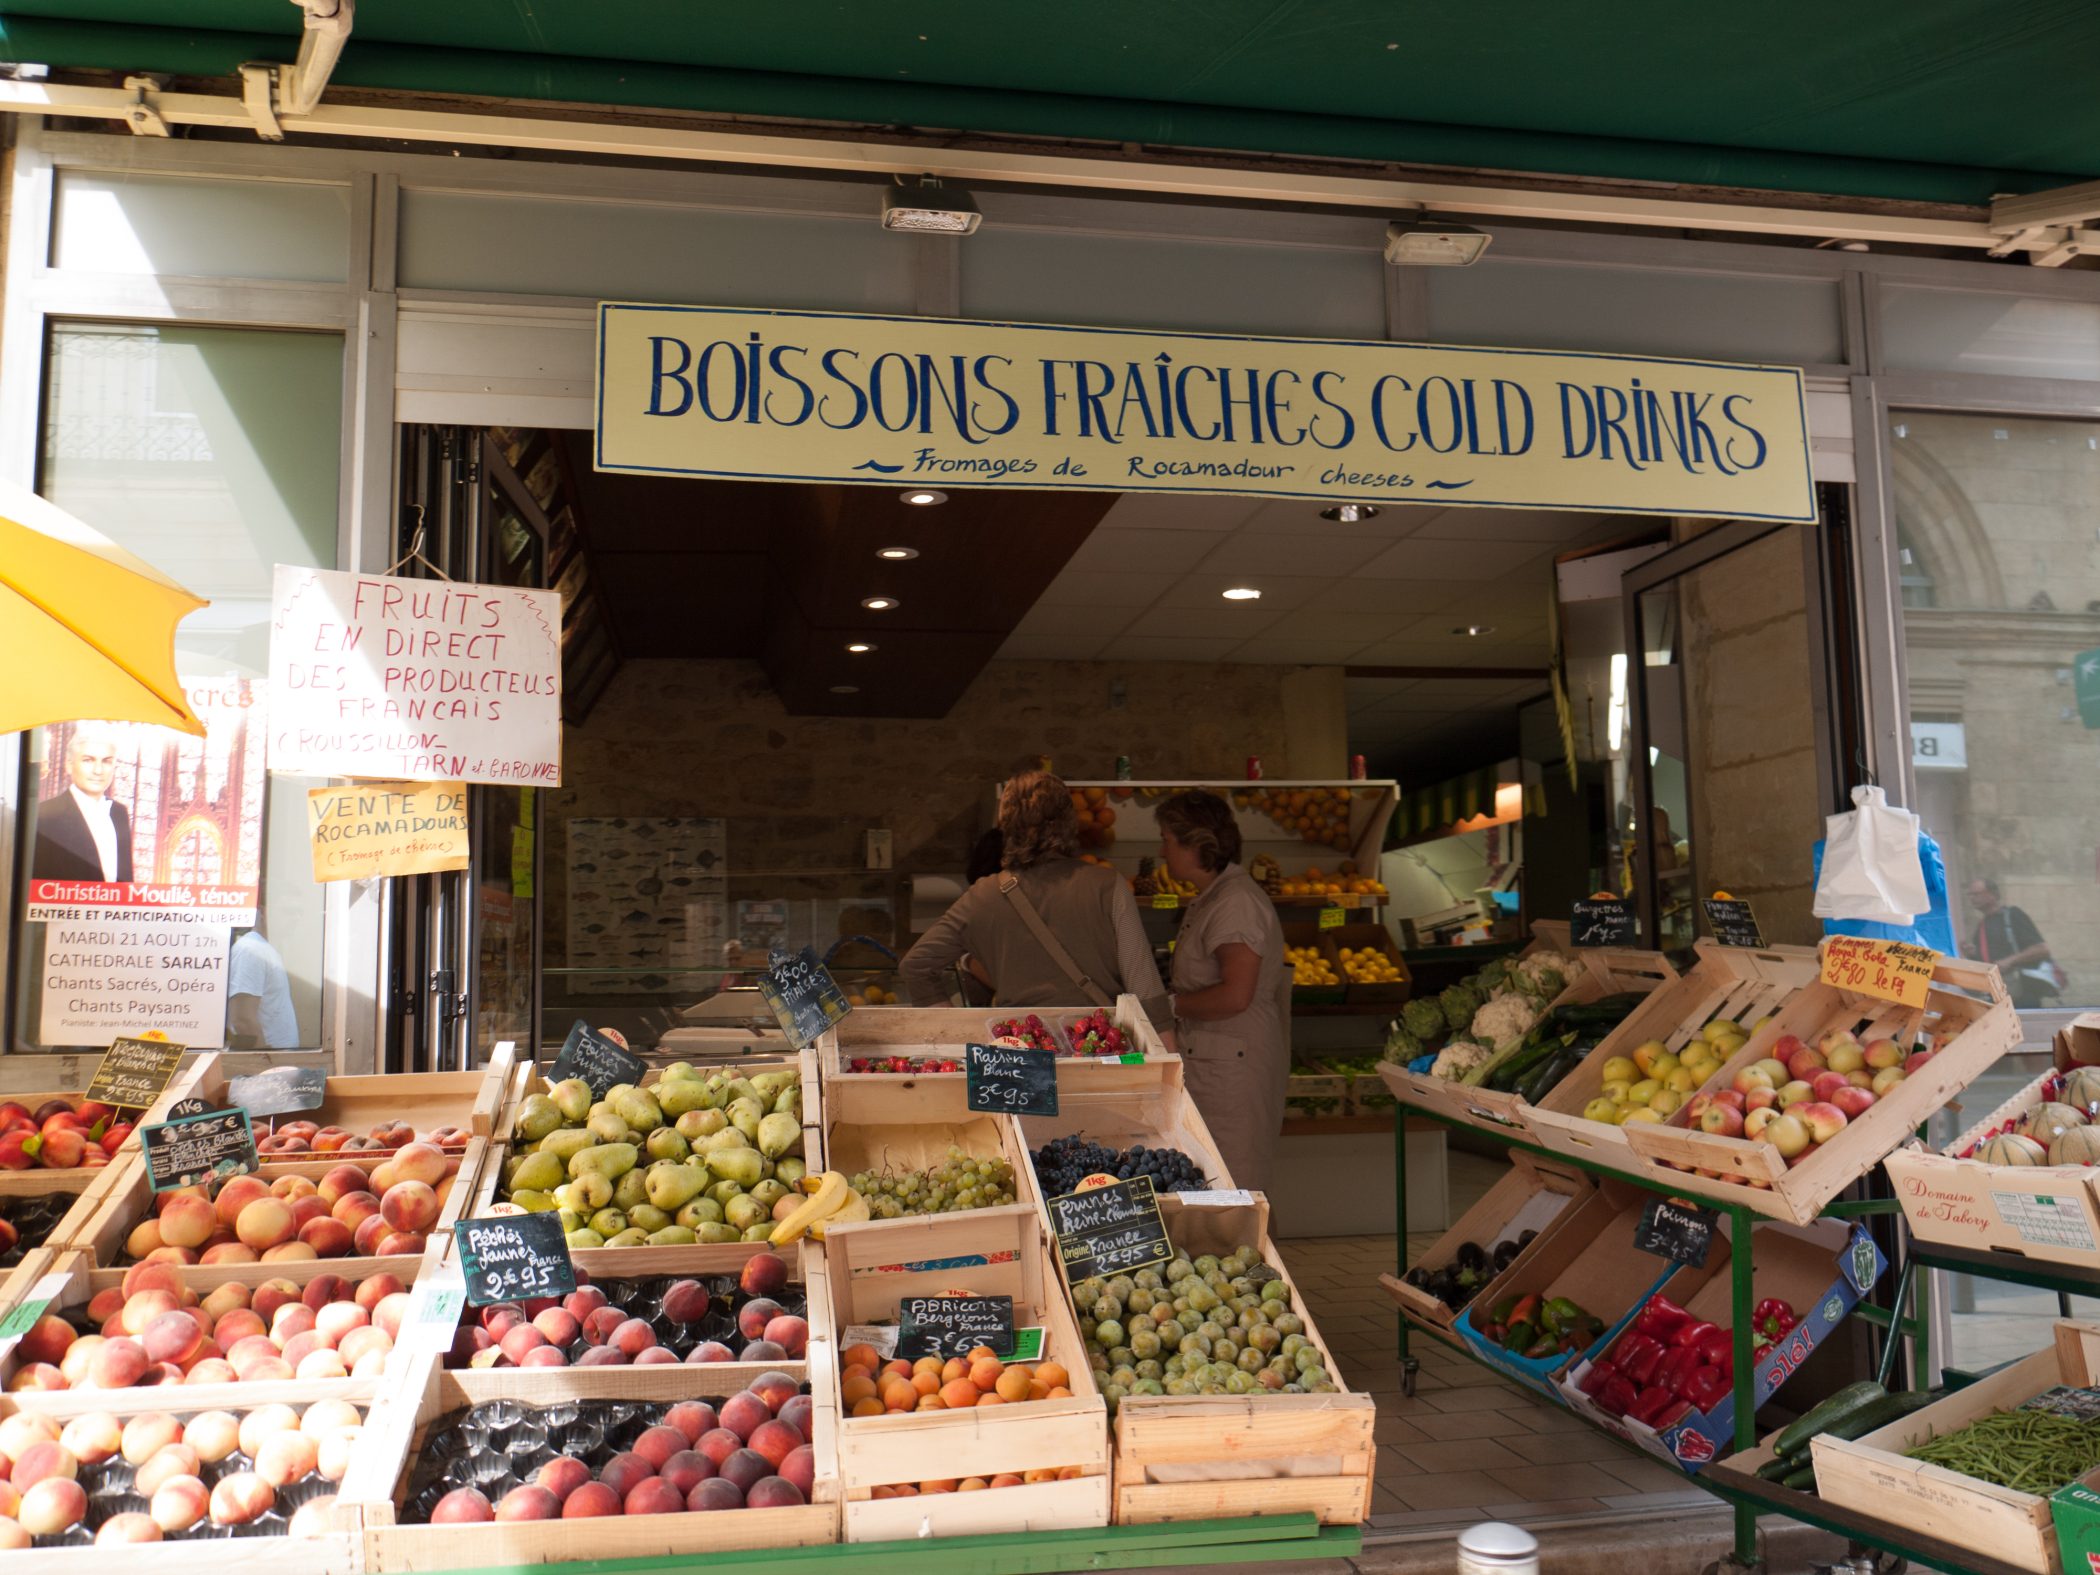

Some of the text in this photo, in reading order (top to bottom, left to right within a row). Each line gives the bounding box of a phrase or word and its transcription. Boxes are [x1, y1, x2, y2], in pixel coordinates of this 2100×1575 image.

[644, 332, 1767, 476] BOISSONS FRAÎCHES COLD DRINKS
[912, 447, 1414, 489] Fromages de Rocamadour cheeses
[353, 581, 501, 628] FRUITS
[315, 623, 506, 660] EN DIRECT
[288, 664, 556, 695] DES PRODUCTEUS
[339, 696, 501, 721] FRANCAIS
[396, 754, 466, 777] TARN
[312, 793, 465, 819] VENTE DE
[315, 815, 468, 844] ROCAMADOURS
[38, 882, 121, 902] Christian
[199, 888, 249, 906] ténor
[30, 907, 81, 920] ENTRÉE
[85, 909, 101, 921] ET
[104, 910, 205, 923] PARTICIPATION
[59, 931, 218, 949] MARDI 21 AOUT 17h
[48, 953, 223, 971] CATHEDRALE SARLAT
[1895, 959, 1933, 979] France
[47, 975, 102, 991] Chants
[167, 979, 216, 996] Opéra
[68, 999, 191, 1018] Chants Paysans
[99, 1019, 150, 1030] Jean-Michel
[151, 1021, 200, 1030] MARTINEZ
[1003, 1036, 1020, 1047] 1kg
[176, 1099, 203, 1115] 1Kg
[1085, 1176, 1107, 1187] 1kg
[1903, 1175, 1976, 1204] Domaine
[1058, 1189, 1123, 1219] Prunes
[1916, 1201, 1990, 1233] de Tabory
[959, 1321, 1004, 1332] France
